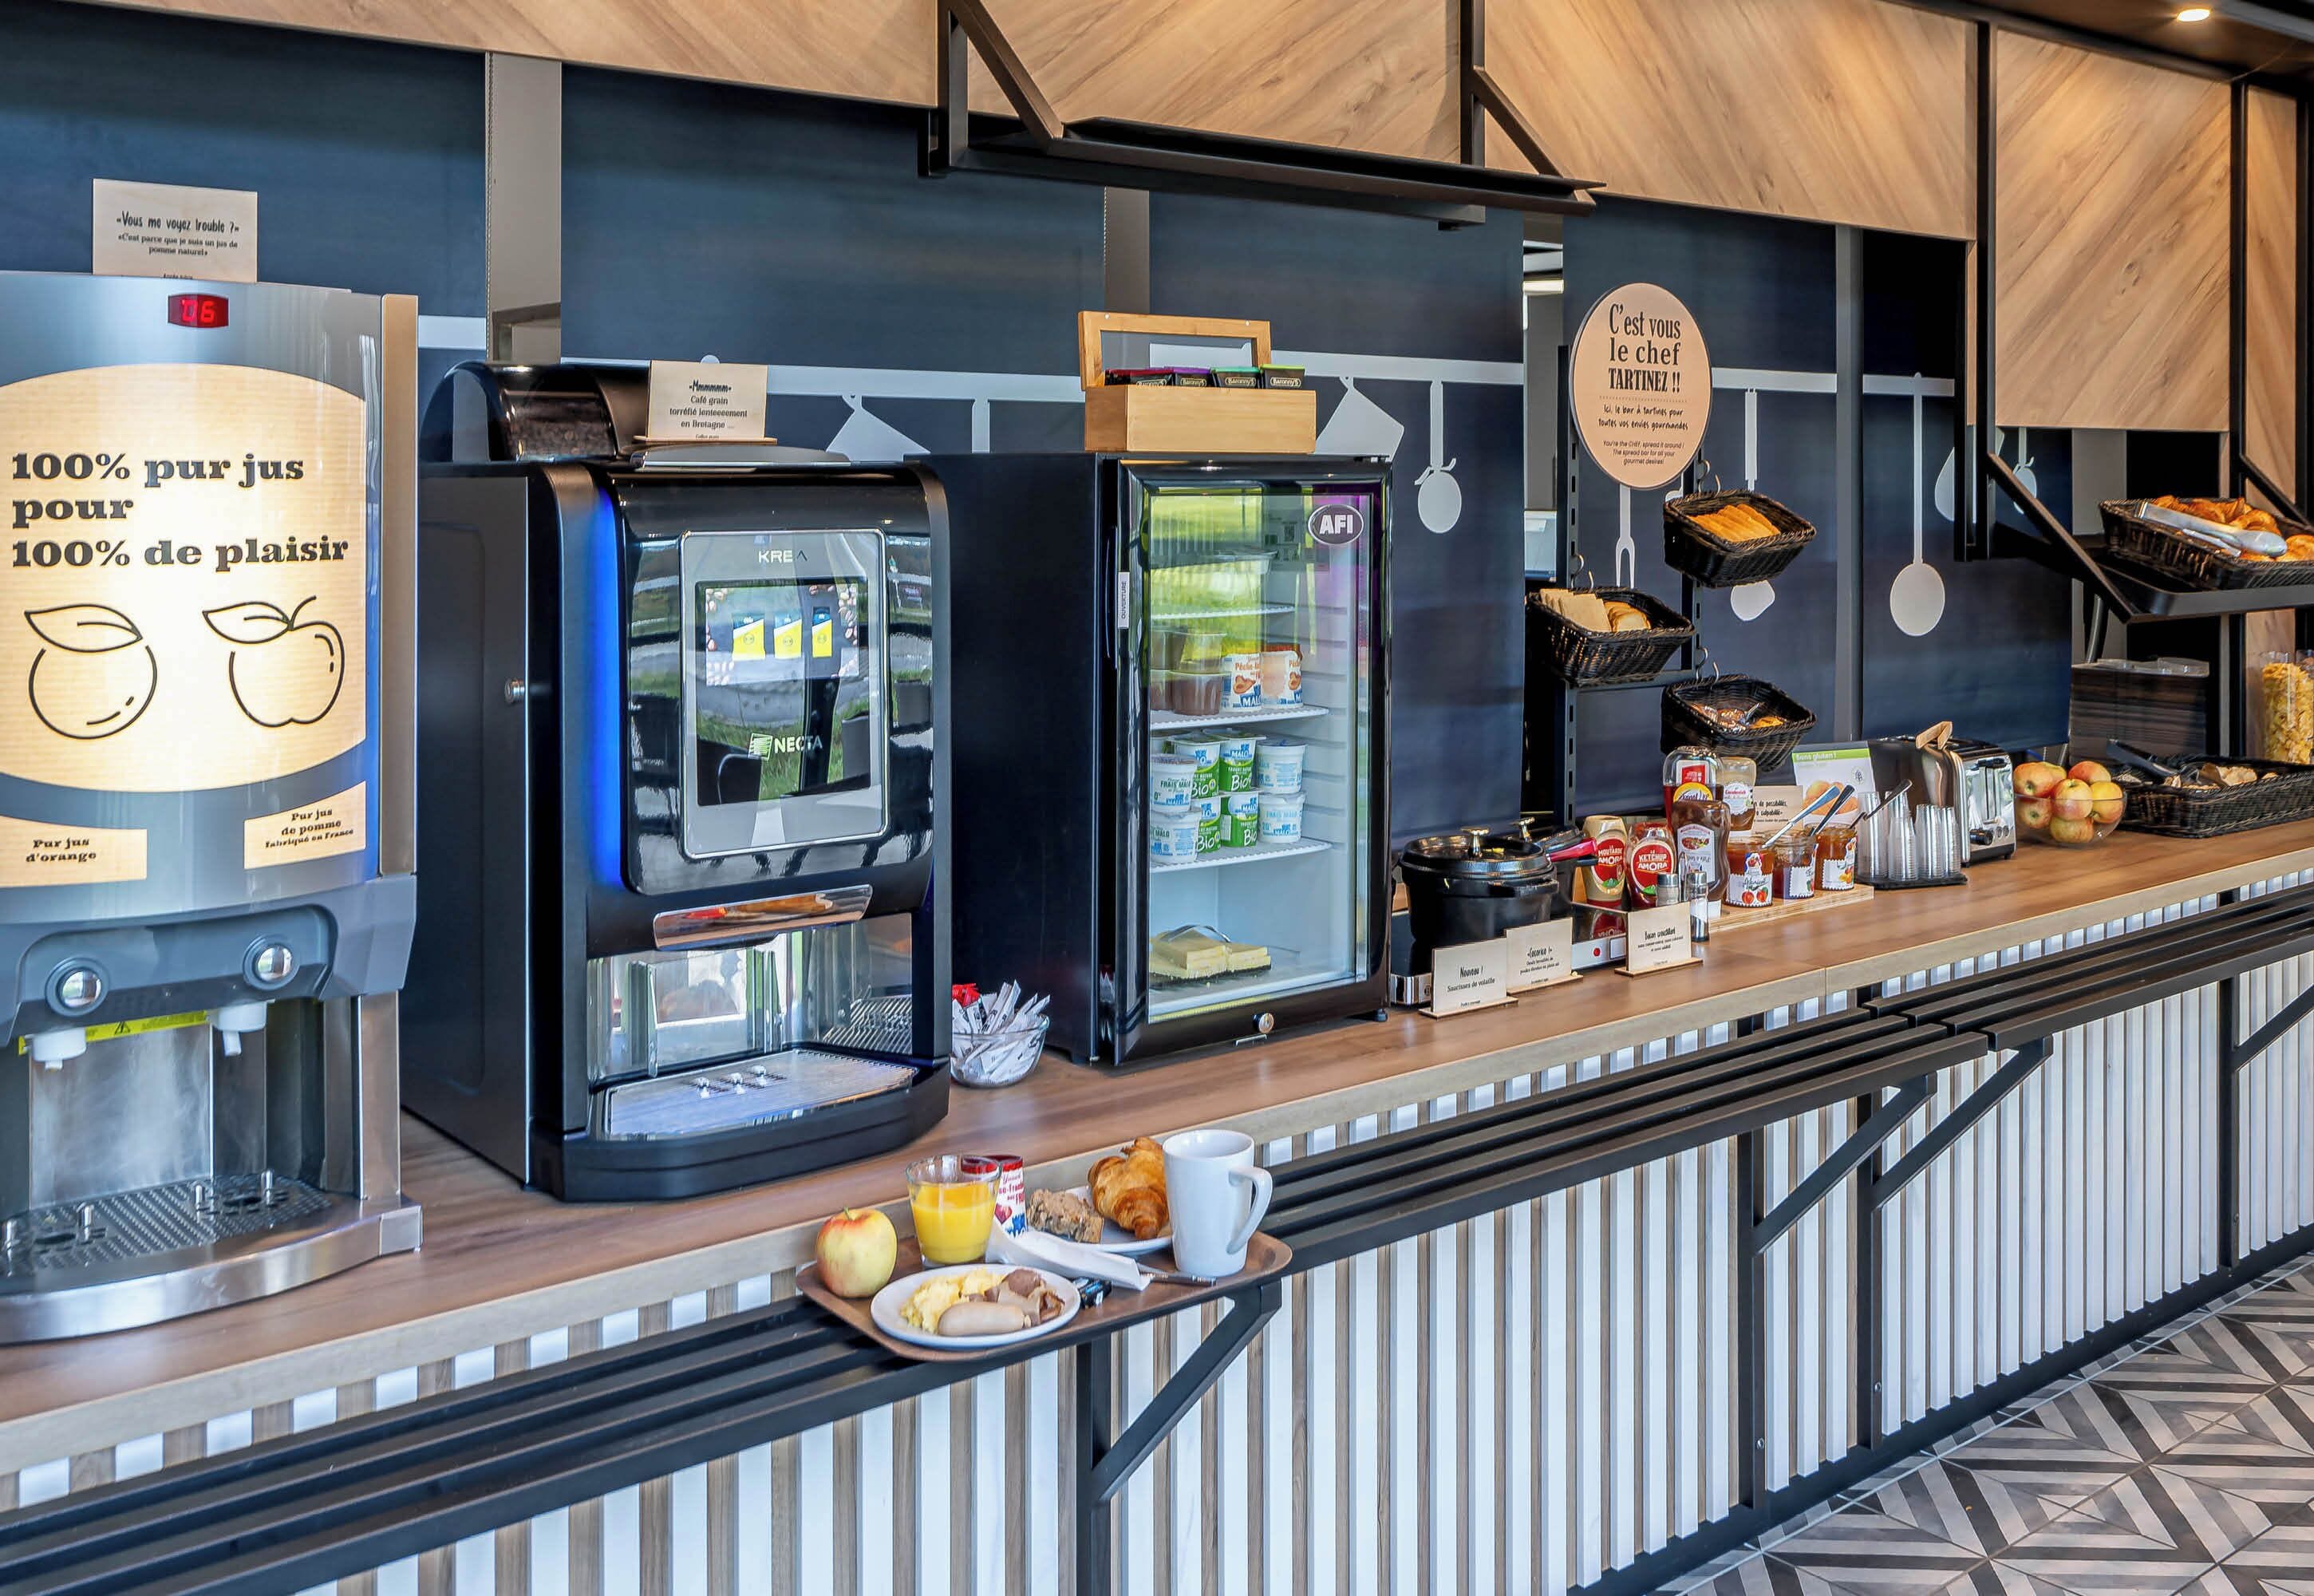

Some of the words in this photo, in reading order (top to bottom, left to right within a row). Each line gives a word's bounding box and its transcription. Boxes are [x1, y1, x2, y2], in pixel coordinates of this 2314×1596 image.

[148, 217, 161, 229] me
[166, 219, 191, 233] voyez
[195, 219, 225, 233] trouble
[148, 247, 176, 255] pomme
[1609, 303, 1645, 337] C'est
[1649, 318, 1680, 339] vous
[1609, 337, 1629, 362] le
[1636, 340, 1681, 365] chef
[1609, 368, 1668, 392] TARTINEZ
[1672, 372, 1680, 393] !!
[690, 395, 707, 405] Café
[709, 397, 729, 406] grain
[669, 407, 697, 416] torréfié
[1615, 405, 1621, 413] le
[1623, 405, 1634, 414] bar
[1637, 403, 1641, 413] à
[1644, 406, 1667, 416] tartines
[1668, 409, 1684, 419] pour
[692, 420, 725, 430] Bretagne
[1598, 418, 1617, 428] toutes
[1631, 420, 1649, 429] envies
[1651, 421, 1688, 432] gourmandes
[12, 452, 131, 480] 100%
[144, 459, 231, 488] pur
[239, 453, 305, 488] jus
[12, 499, 134, 529] pour
[1319, 514, 1353, 535] AFI
[12, 539, 131, 567] 100%
[144, 539, 203, 566] de
[215, 535, 349, 573] plaisir
[774, 734, 823, 754] NECTA
[1231, 775, 1249, 791] Bio
[291, 812, 314, 822] Pur
[315, 808, 333, 820] jus
[281, 826, 296, 836] de
[299, 820, 342, 836] pomme
[325, 829, 354, 839] France
[33, 839, 62, 848] Pur
[65, 837, 89, 849] jus
[1196, 836, 1215, 852] Bio
[26, 851, 97, 863] d'orange
[1598, 855, 1623, 865] AMORA
[1638, 853, 1668, 862] KETCHUP
[1638, 862, 1668, 871] AMORA
[1460, 966, 1479, 979] Nouveau
[1447, 982, 1471, 993] Saucisses
[1478, 978, 1495, 986] volaille
